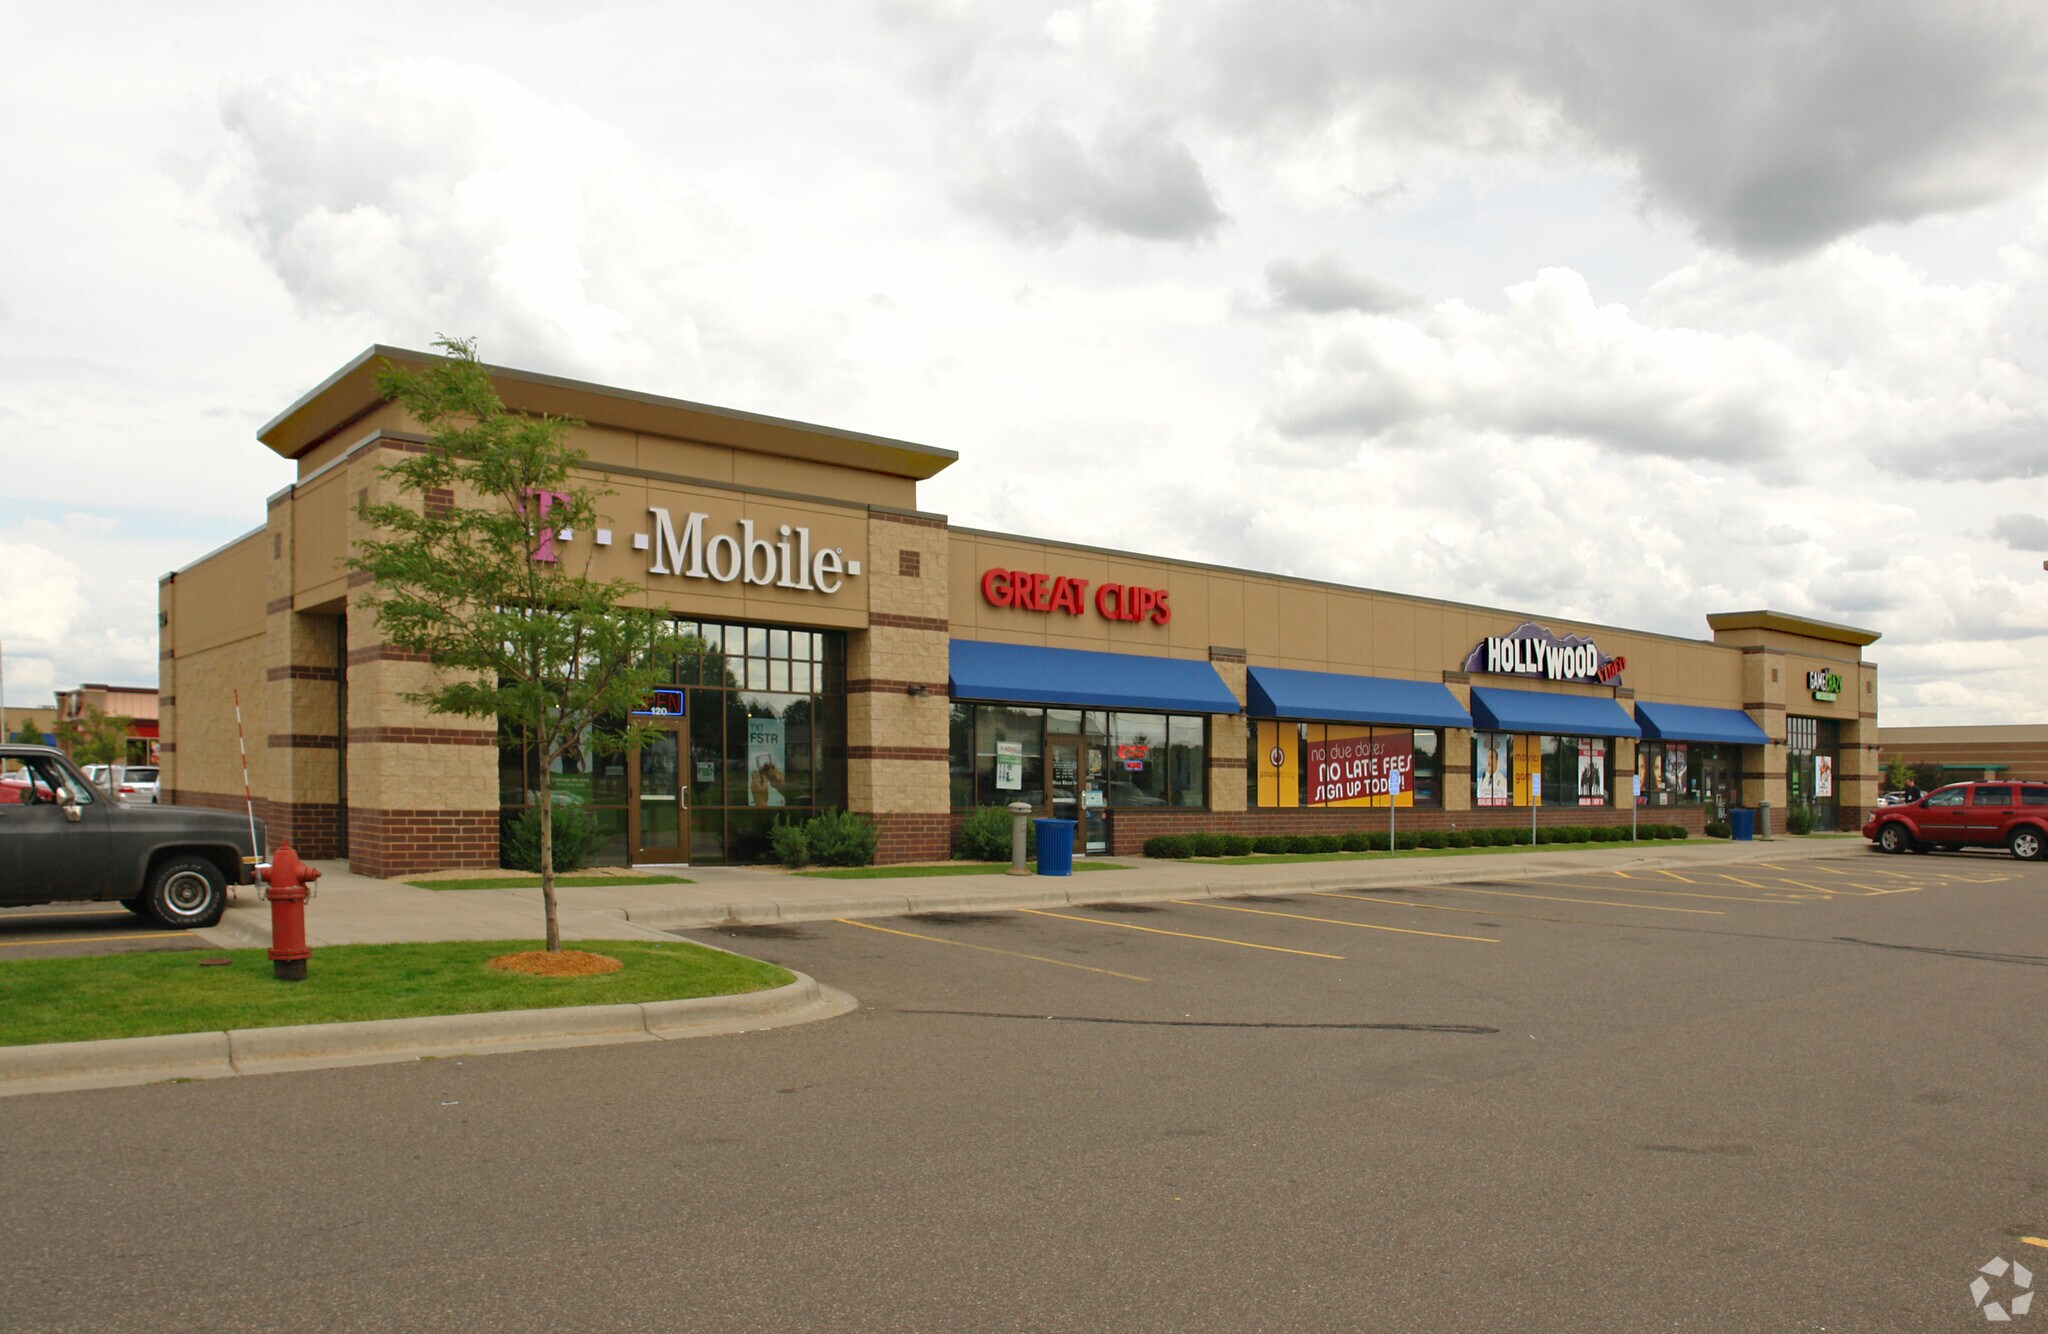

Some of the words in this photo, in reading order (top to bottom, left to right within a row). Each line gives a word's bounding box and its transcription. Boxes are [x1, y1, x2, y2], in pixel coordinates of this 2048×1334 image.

[981, 567, 1090, 616] GREAT
[1095, 583, 1172, 625] CLIPS
[1488, 637, 1598, 680] HOLLYWOOD
[1598, 656, 1626, 683] VIDEO
[631, 692, 681, 713] PEN
[651, 707, 667, 716] 120
[750, 732, 779, 744] FSTR
[1311, 748, 1325, 762] no
[1330, 743, 1352, 760] due
[1319, 762, 1341, 782] NO
[1345, 757, 1379, 779] LATE
[1383, 754, 1413, 775] FEES
[1315, 782, 1344, 801] SIGN
[1346, 782, 1362, 797] UP
[1363, 778, 1405, 793] TOD!
